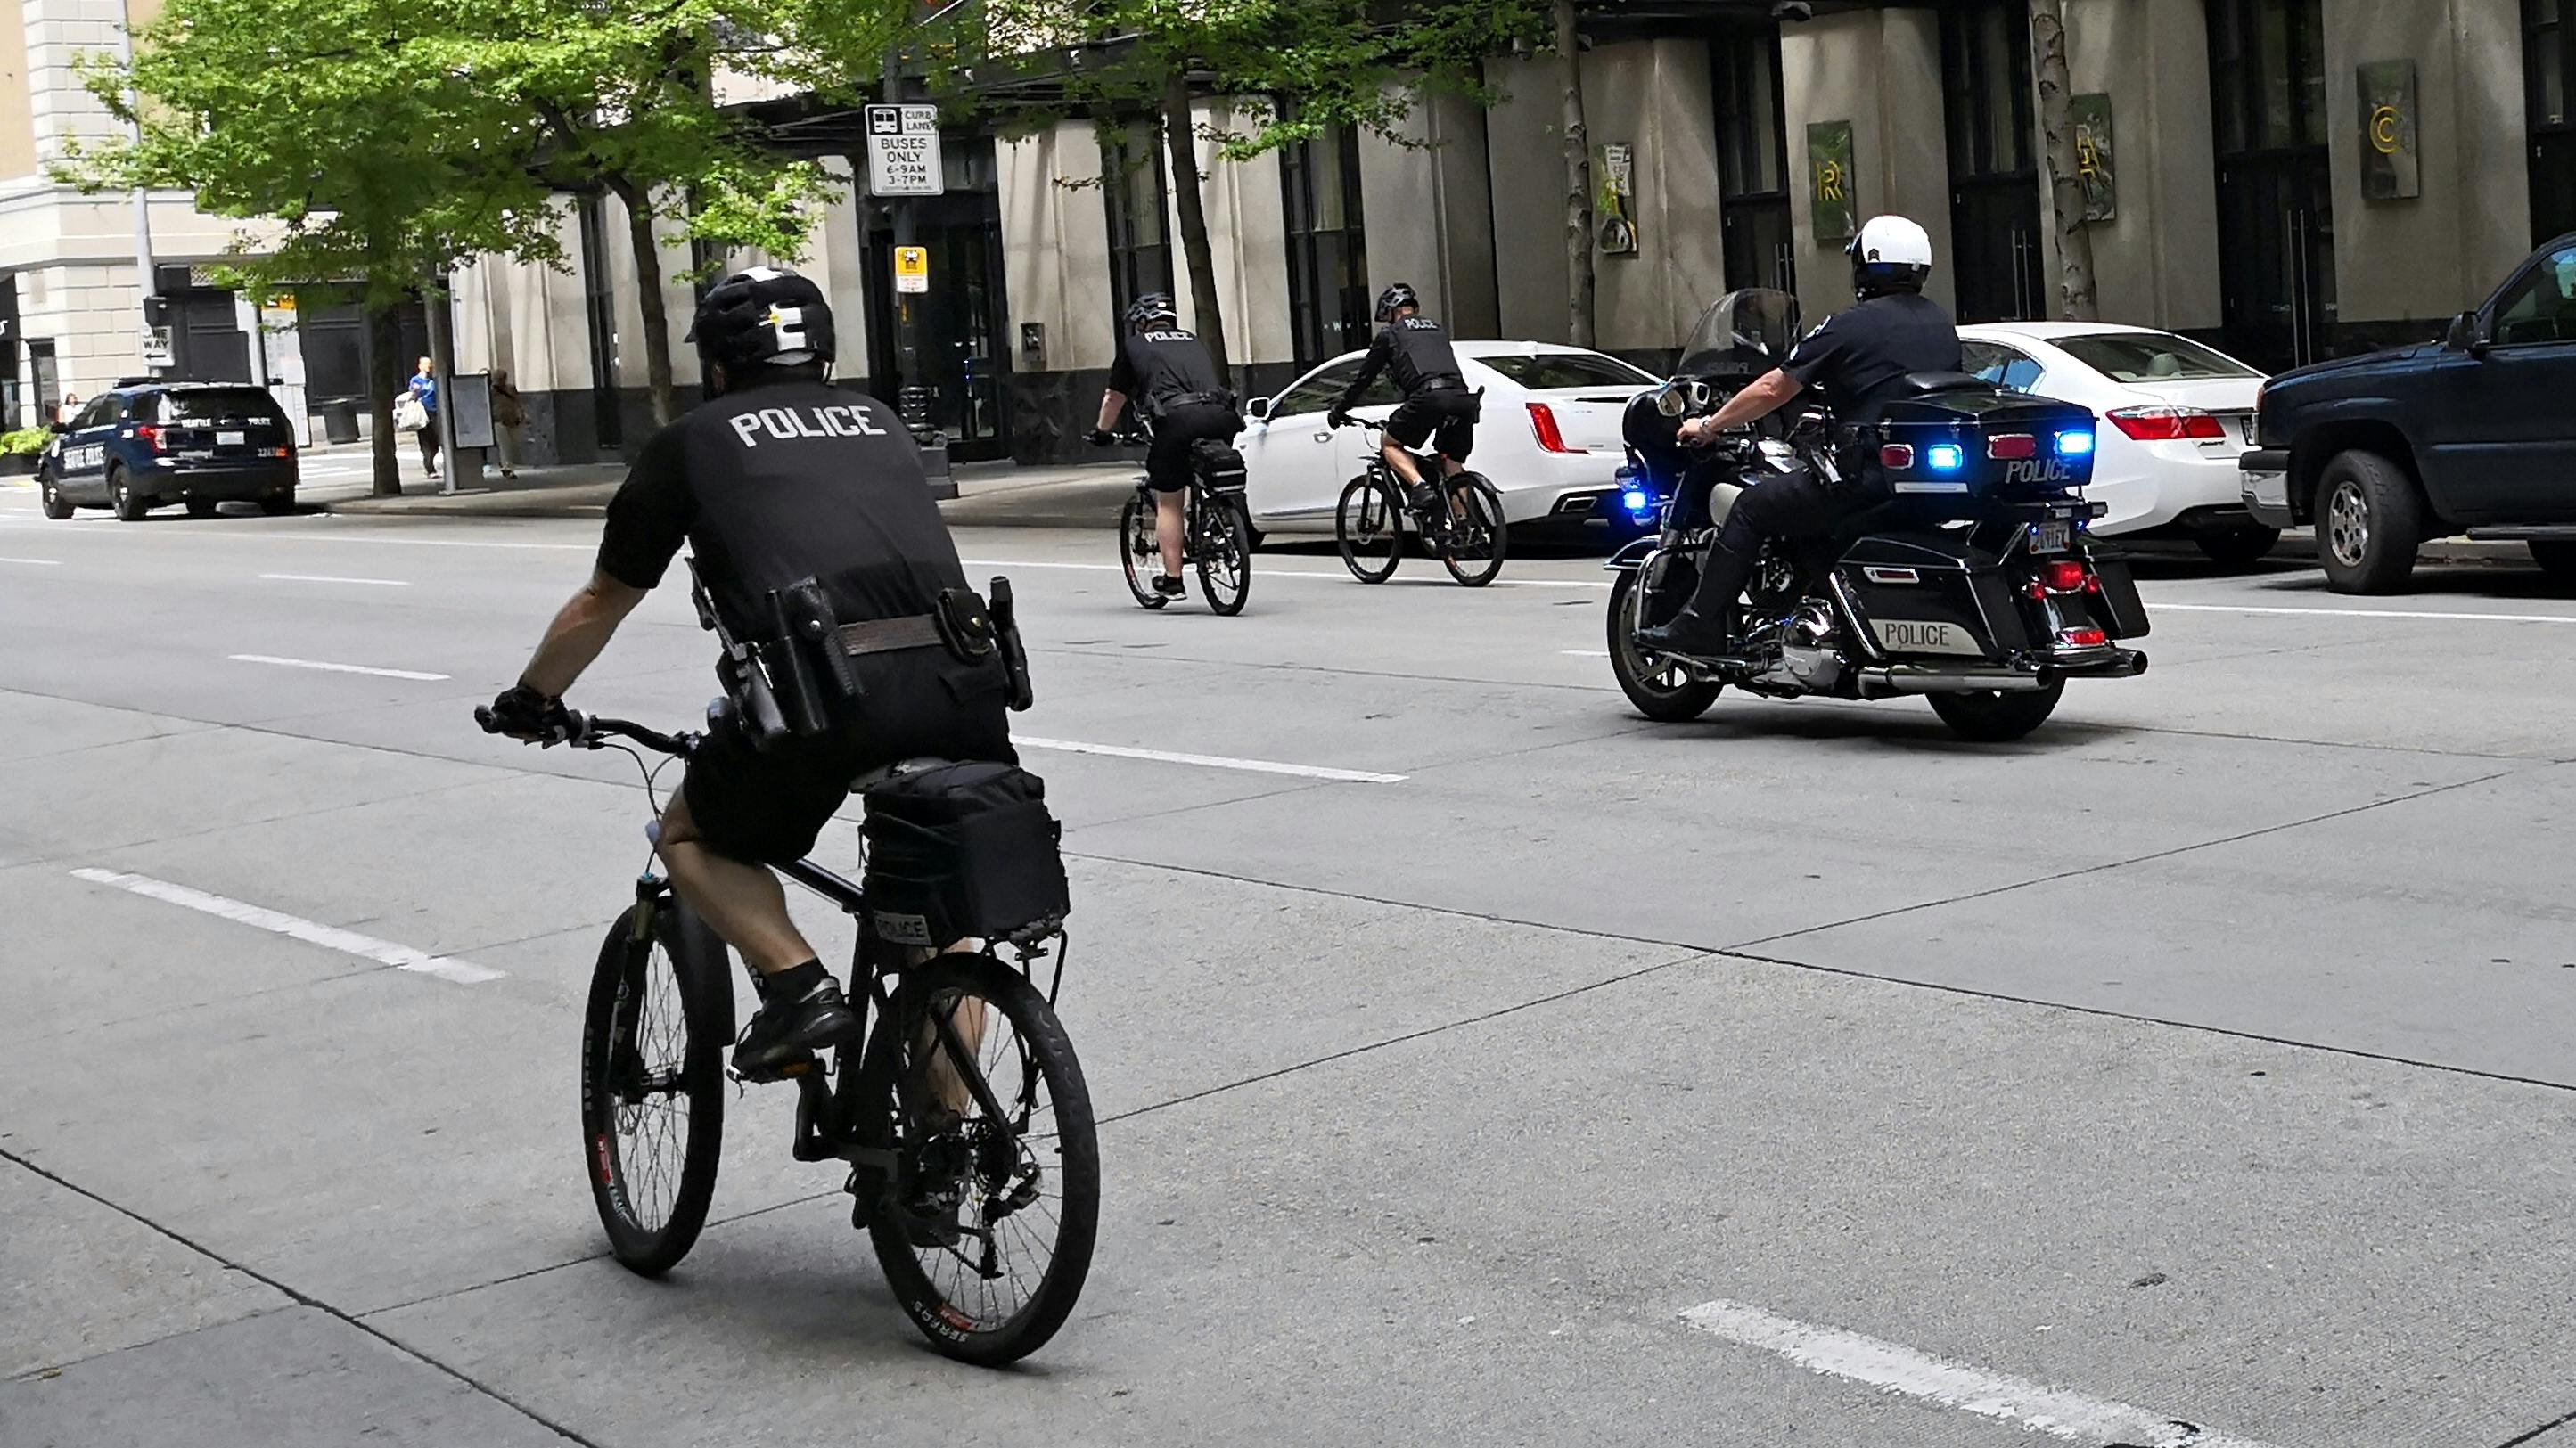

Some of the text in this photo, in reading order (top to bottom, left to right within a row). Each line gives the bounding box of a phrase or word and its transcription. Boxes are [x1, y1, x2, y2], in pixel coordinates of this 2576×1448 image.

[905, 110, 932, 119] CURB
[906, 121, 931, 131] LANE
[881, 137, 927, 150] BUSES
[887, 151, 922, 163] ONLY
[887, 165, 926, 174] 6-9AM
[889, 176, 926, 184] 3-7PM
[1816, 160, 1844, 200] R
[1404, 317, 1440, 330] POLICE
[1144, 331, 1194, 343] POLICE
[143, 340, 168, 349] WAY
[729, 405, 887, 447] POLICE
[2005, 459, 2071, 484] POLICE
[1884, 623, 1950, 647] POLICE
